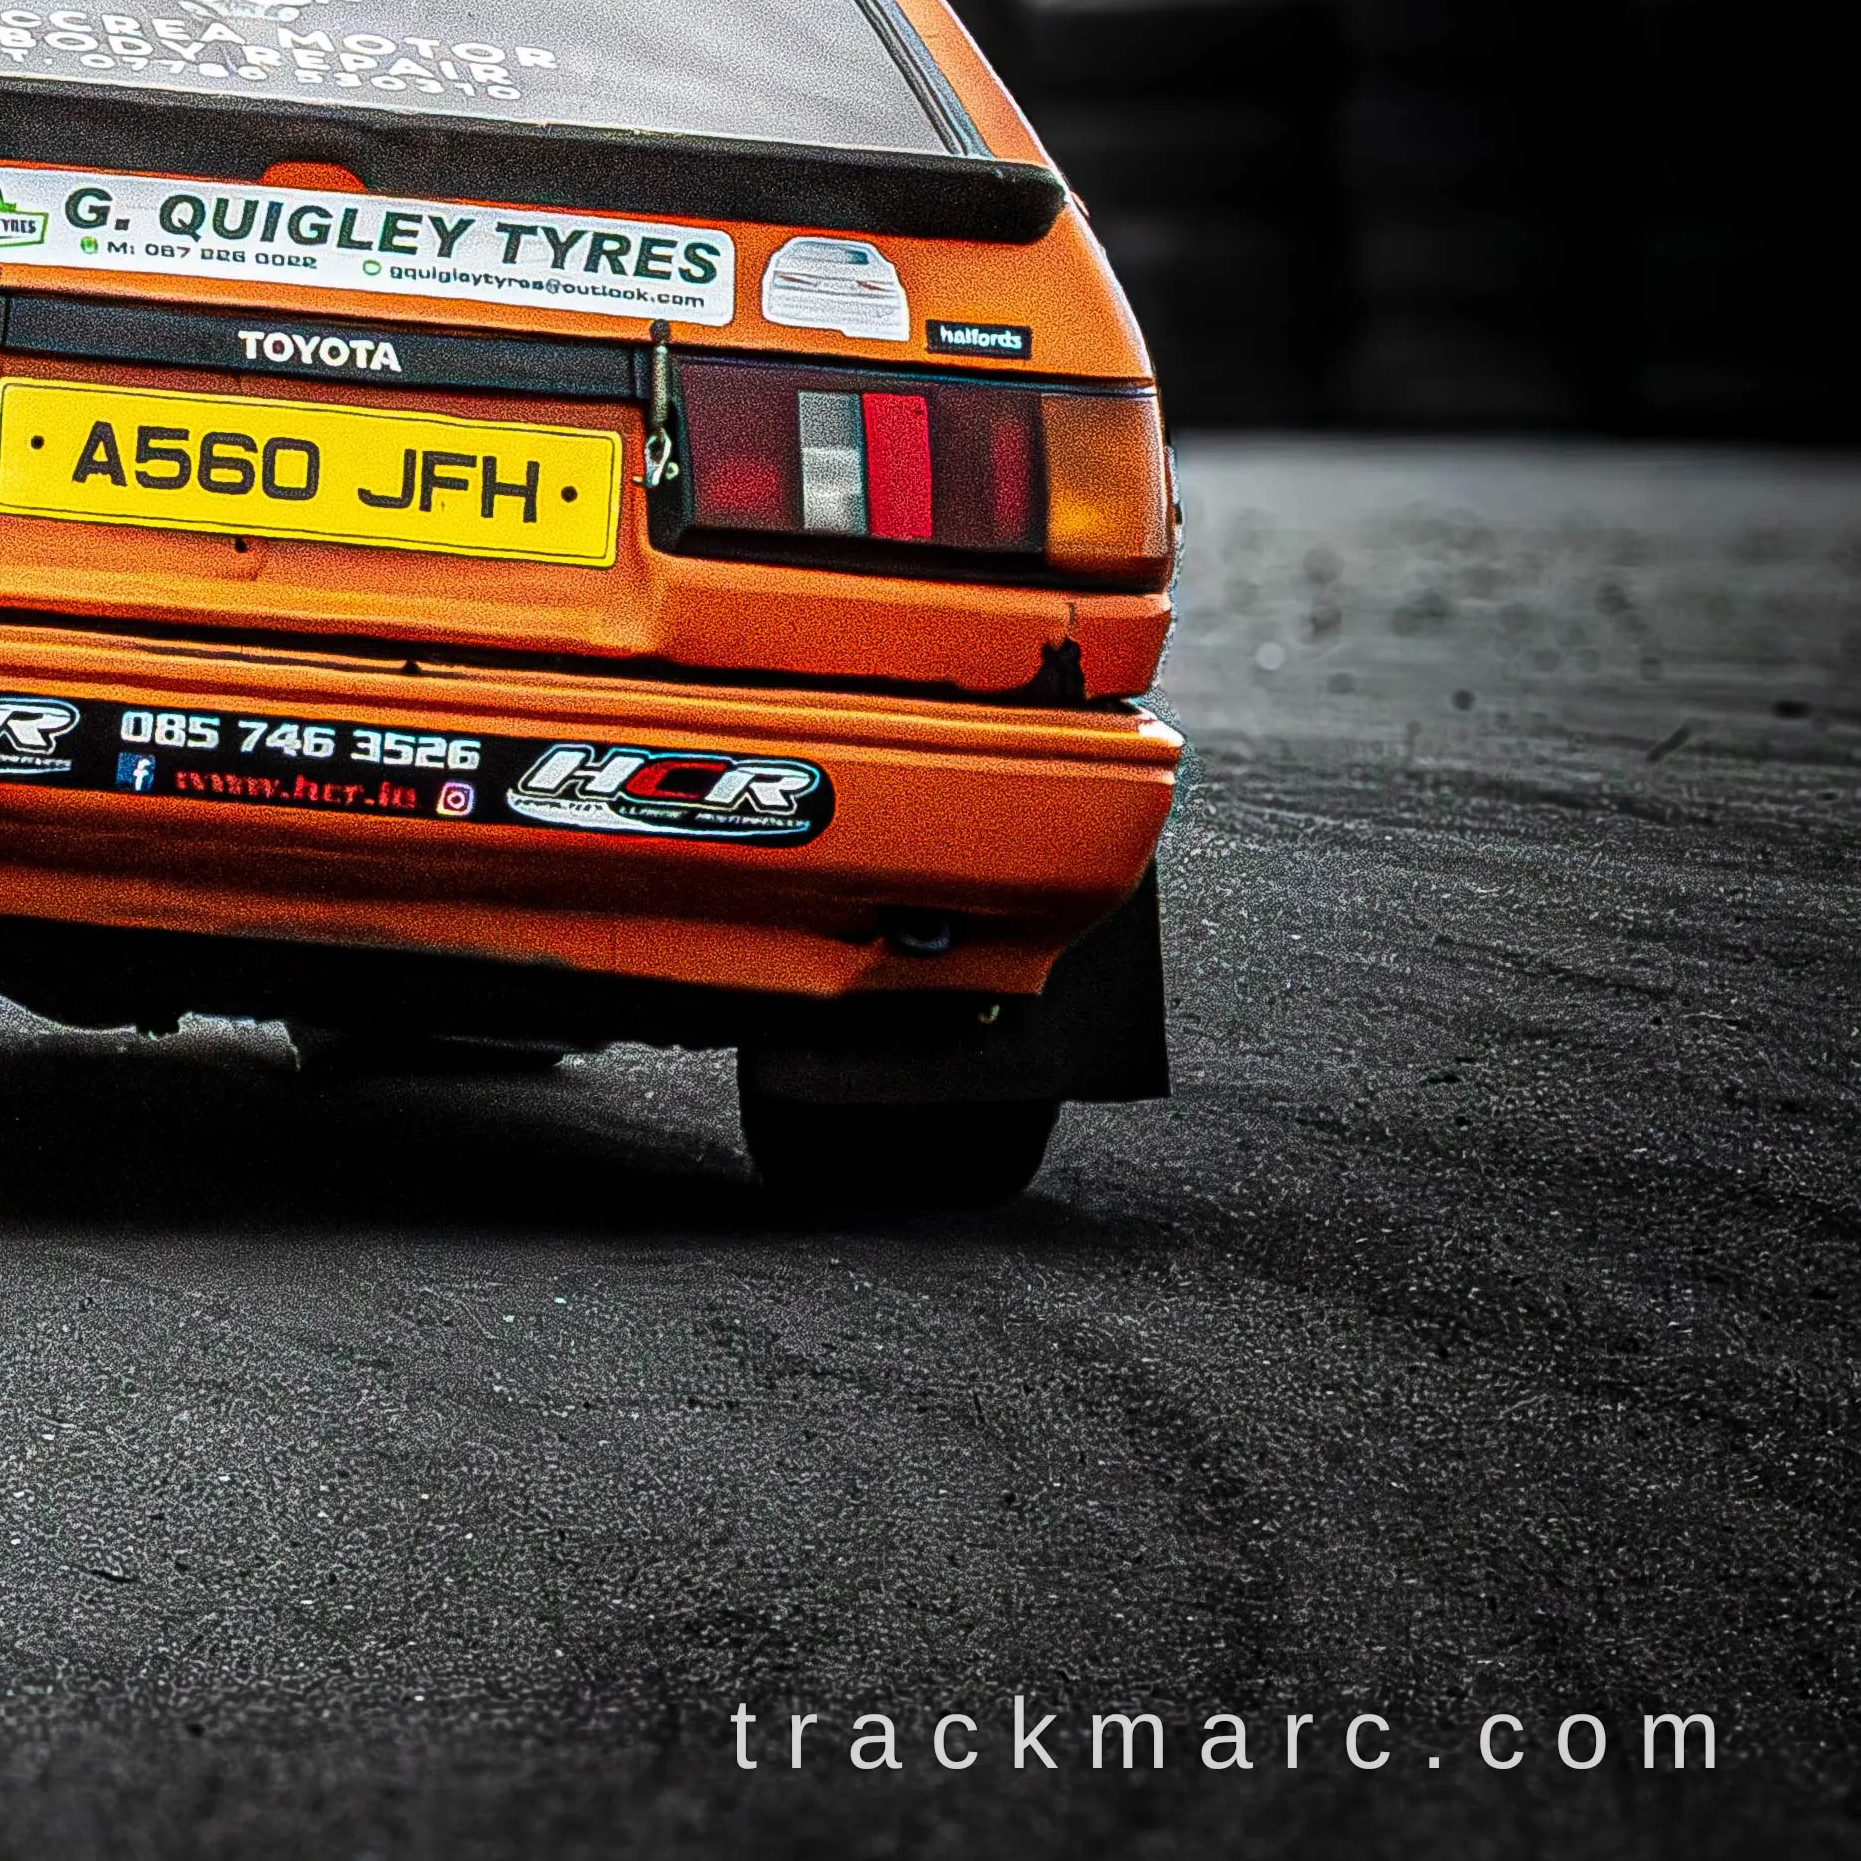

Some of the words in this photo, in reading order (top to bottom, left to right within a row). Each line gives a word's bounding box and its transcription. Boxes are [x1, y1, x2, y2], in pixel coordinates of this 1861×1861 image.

[242, 44, 514, 86] REPAIR
[277, 26, 558, 70] MOTOR
[64, 186, 131, 231] G.
[158, 194, 476, 258] QUIGLEY
[495, 221, 721, 285] TYRES
[237, 330, 403, 373] TOYOTA
[939, 325, 1023, 350] halfords
[70, 419, 321, 502] A560
[357, 447, 541, 525] JFH
[120, 710, 220, 750] 085
[238, 719, 336, 757] 746
[350, 729, 482, 771] 3526
[518, 744, 820, 814] HCR
